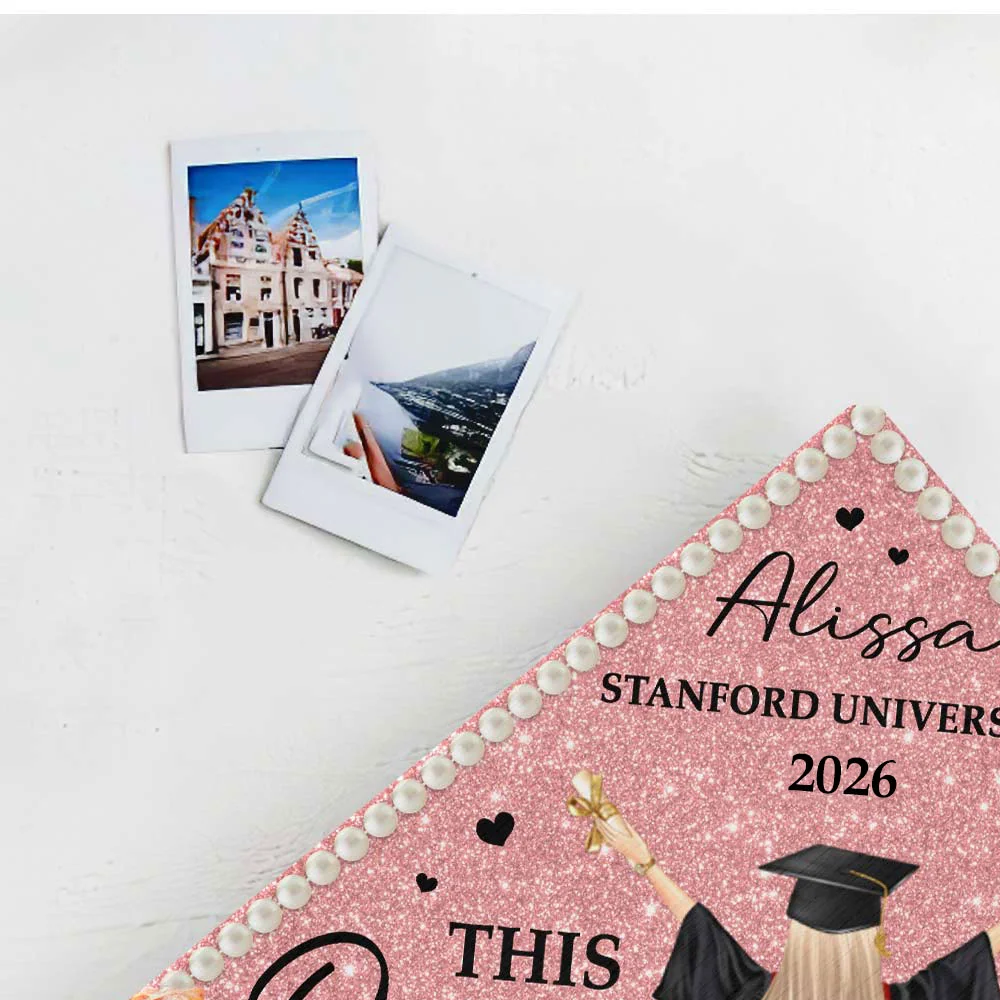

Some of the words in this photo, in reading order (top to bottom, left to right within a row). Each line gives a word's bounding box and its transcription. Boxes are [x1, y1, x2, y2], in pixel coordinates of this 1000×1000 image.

[600, 672, 819, 720] STANFORD
[788, 753, 898, 798] 2026
[449, 921, 621, 990] THIS
